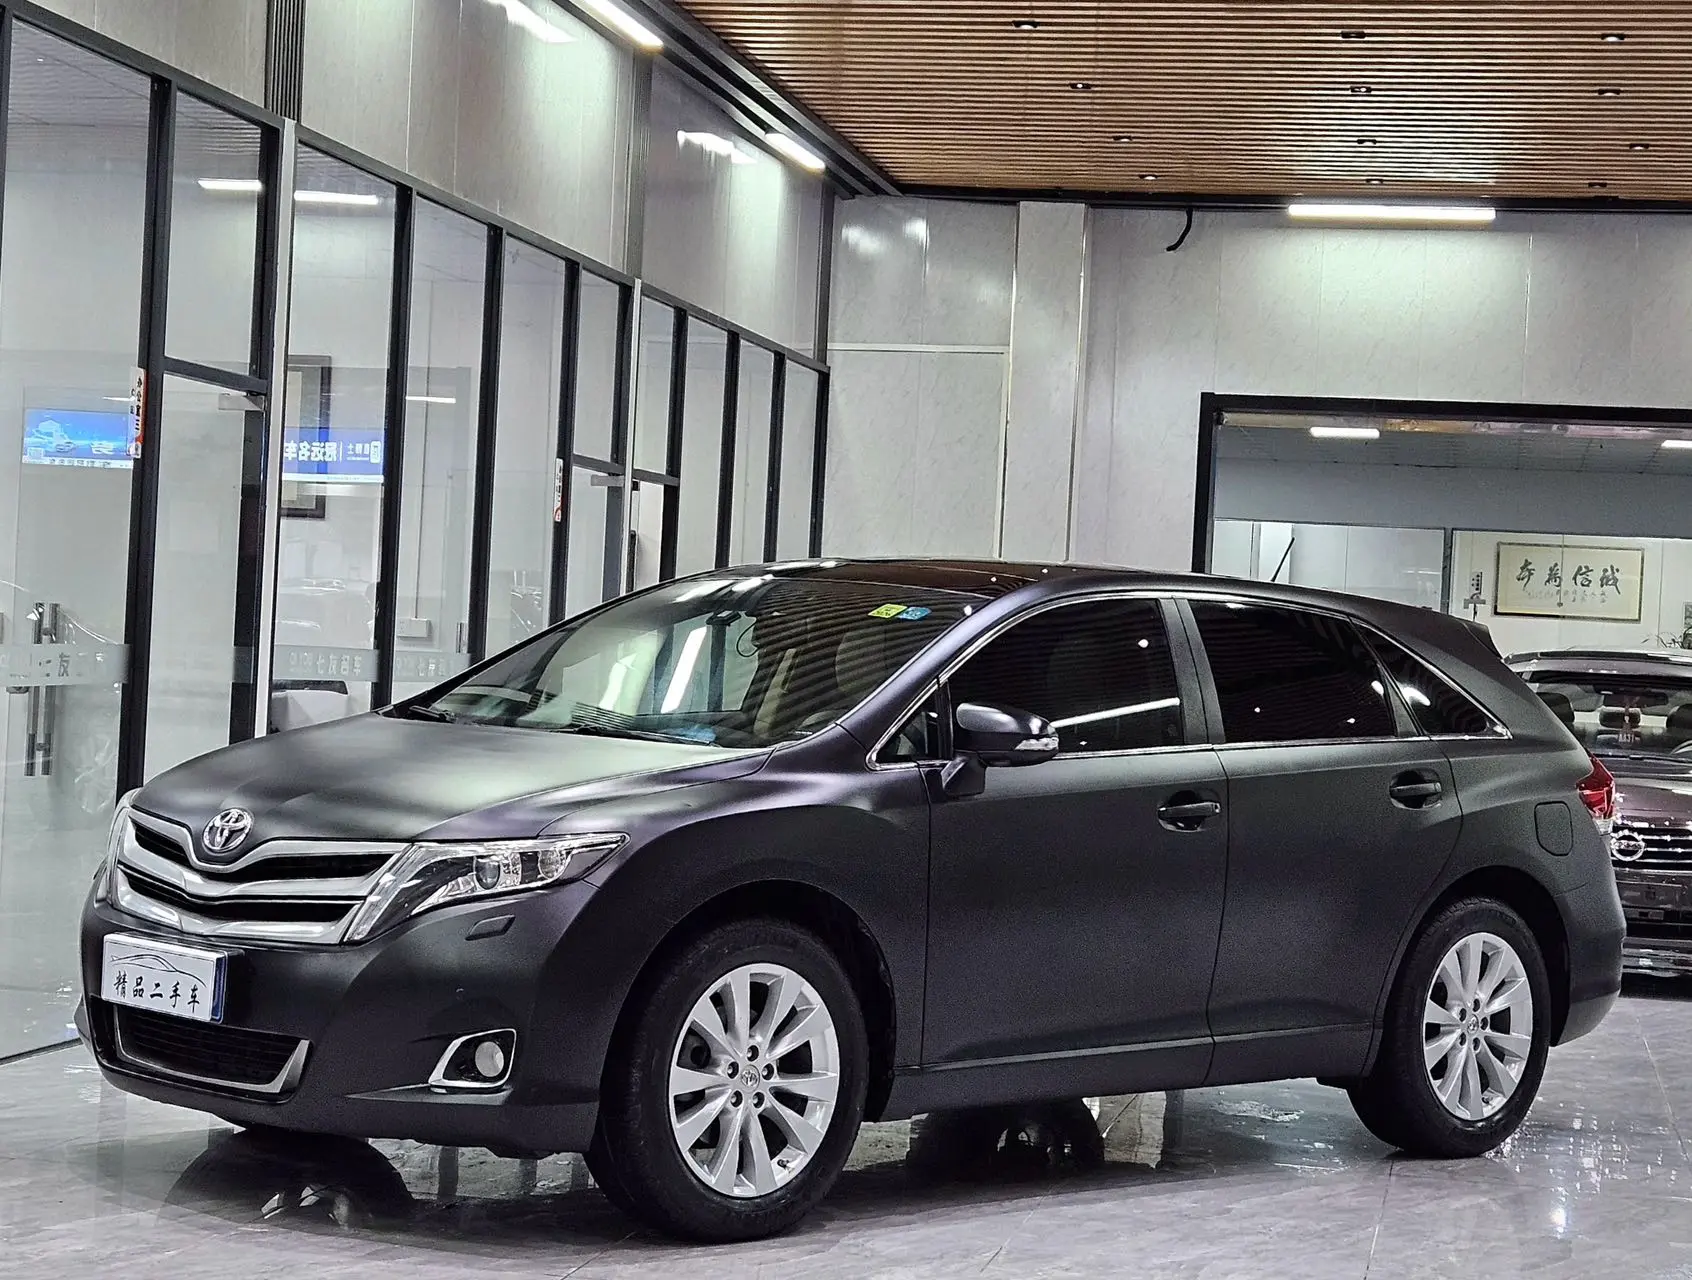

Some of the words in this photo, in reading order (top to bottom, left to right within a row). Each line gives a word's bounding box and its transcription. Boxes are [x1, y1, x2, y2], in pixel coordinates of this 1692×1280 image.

[113, 971, 200, 1013] 精品二手车
